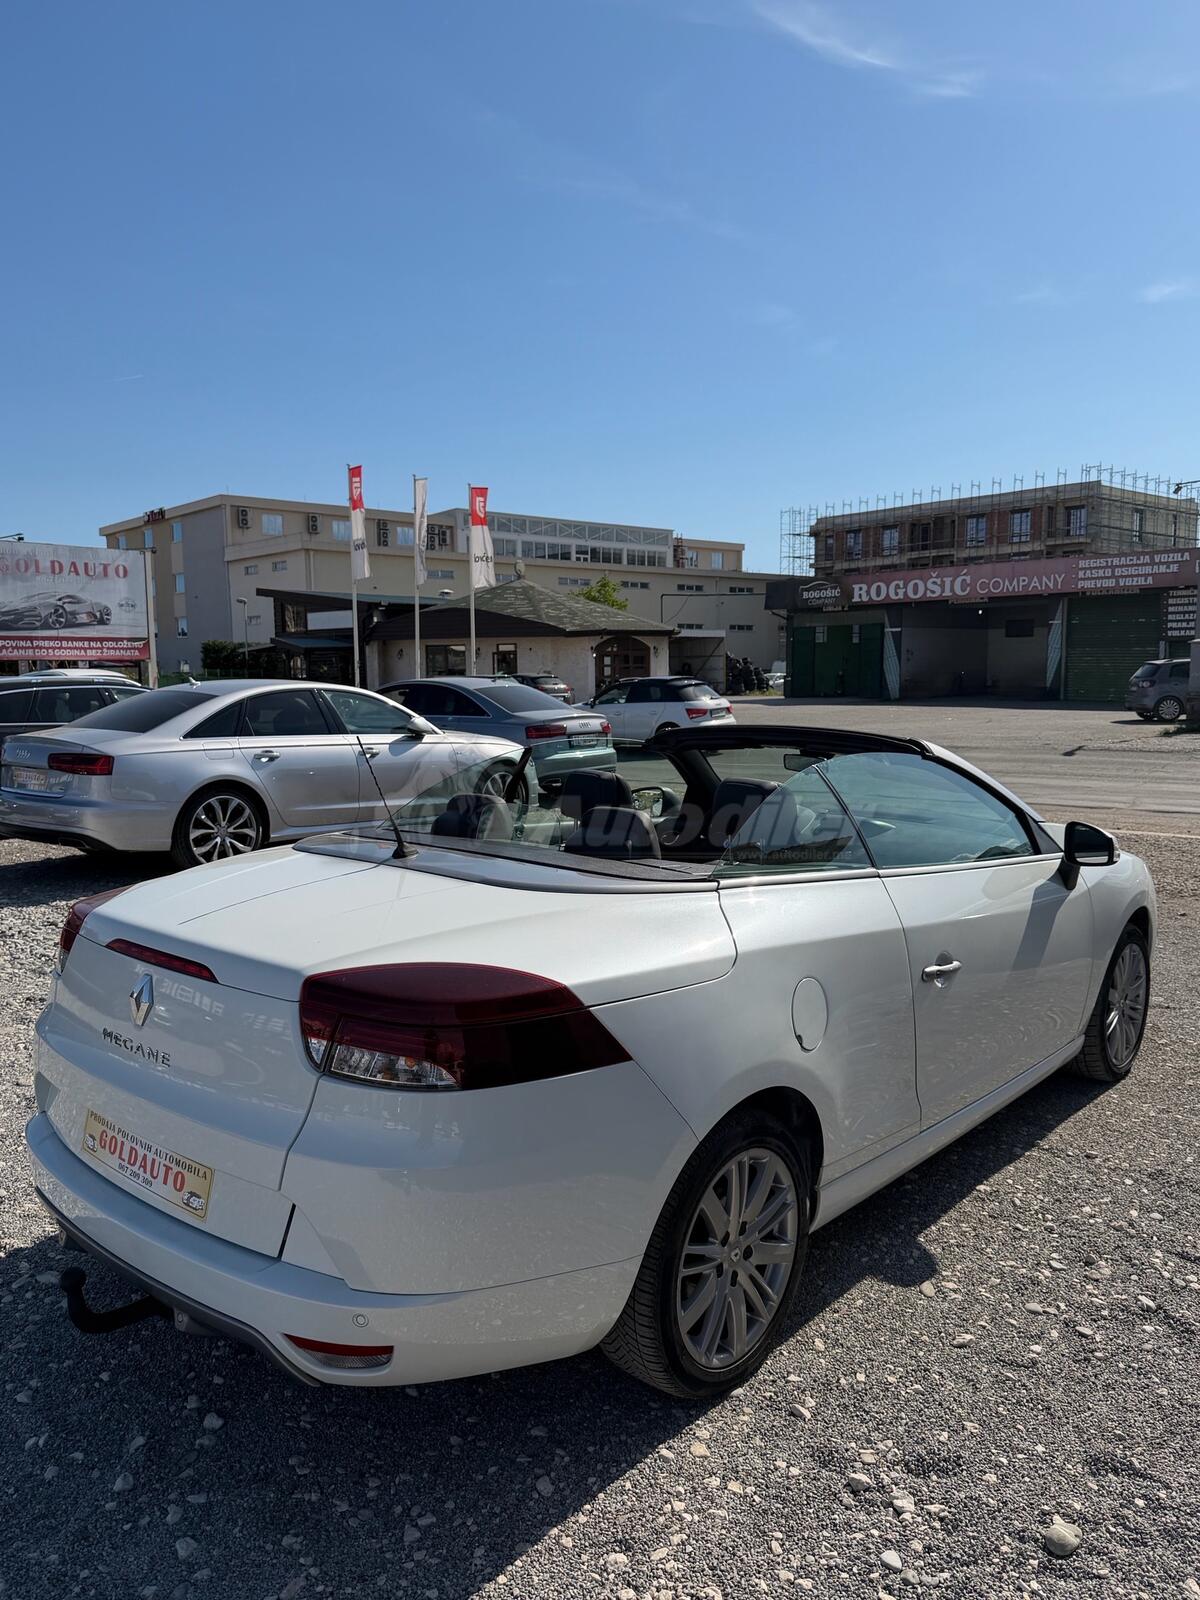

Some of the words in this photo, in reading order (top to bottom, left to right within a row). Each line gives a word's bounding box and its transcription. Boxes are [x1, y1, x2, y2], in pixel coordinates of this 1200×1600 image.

[1078, 556, 1151, 569] REGISTRACIJA
[1154, 552, 1190, 563] VOZILA
[1078, 568, 1112, 579] KASKO
[1115, 563, 1179, 576] OSIGURANJE
[802, 586, 841, 599] ROGOŠIĆ
[852, 569, 971, 602] ROGOŠIĆ
[976, 574, 1065, 594] COMPANY
[1077, 578, 1116, 589] PREVOD
[1119, 576, 1153, 586] VOZILA
[32, 640, 61, 648] PREKO
[62, 640, 89, 648] BANKE
[102, 1027, 171, 1068] MEGANE
[90, 1110, 116, 1134] PRODAJA
[116, 1126, 152, 1153] POLOVNIH
[153, 1149, 208, 1181] AUTOMOBILA
[98, 1129, 186, 1193] GOLDAUTO
[118, 1162, 128, 1173] 067
[129, 1168, 141, 1181] 209
[141, 1175, 153, 1188] 309
